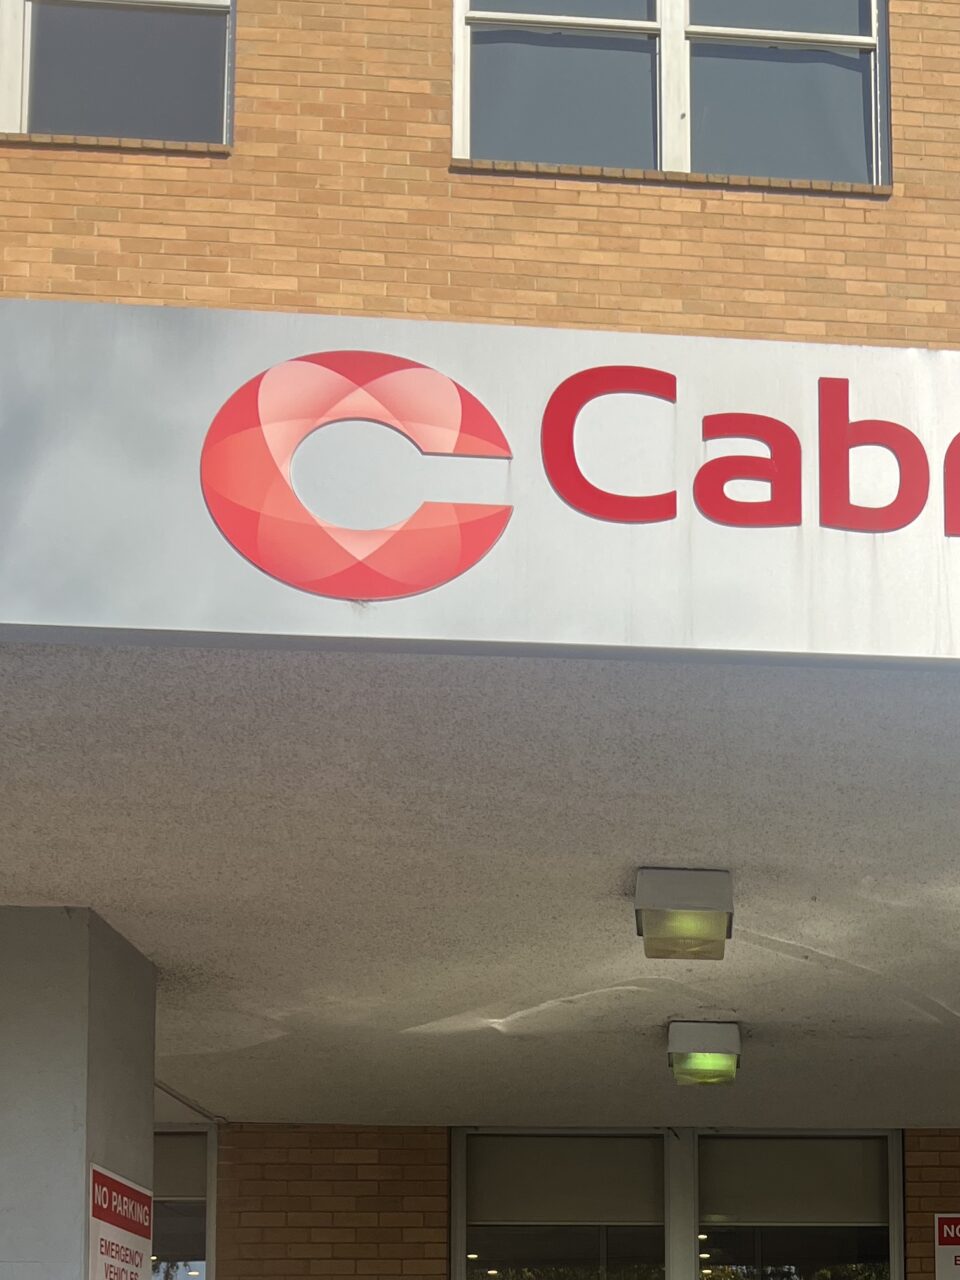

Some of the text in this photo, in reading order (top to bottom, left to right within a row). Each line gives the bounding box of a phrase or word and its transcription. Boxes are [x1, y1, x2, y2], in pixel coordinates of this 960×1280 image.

[94, 1183, 150, 1227] NO PARKING
[99, 1238, 144, 1269] EMERGENCY
